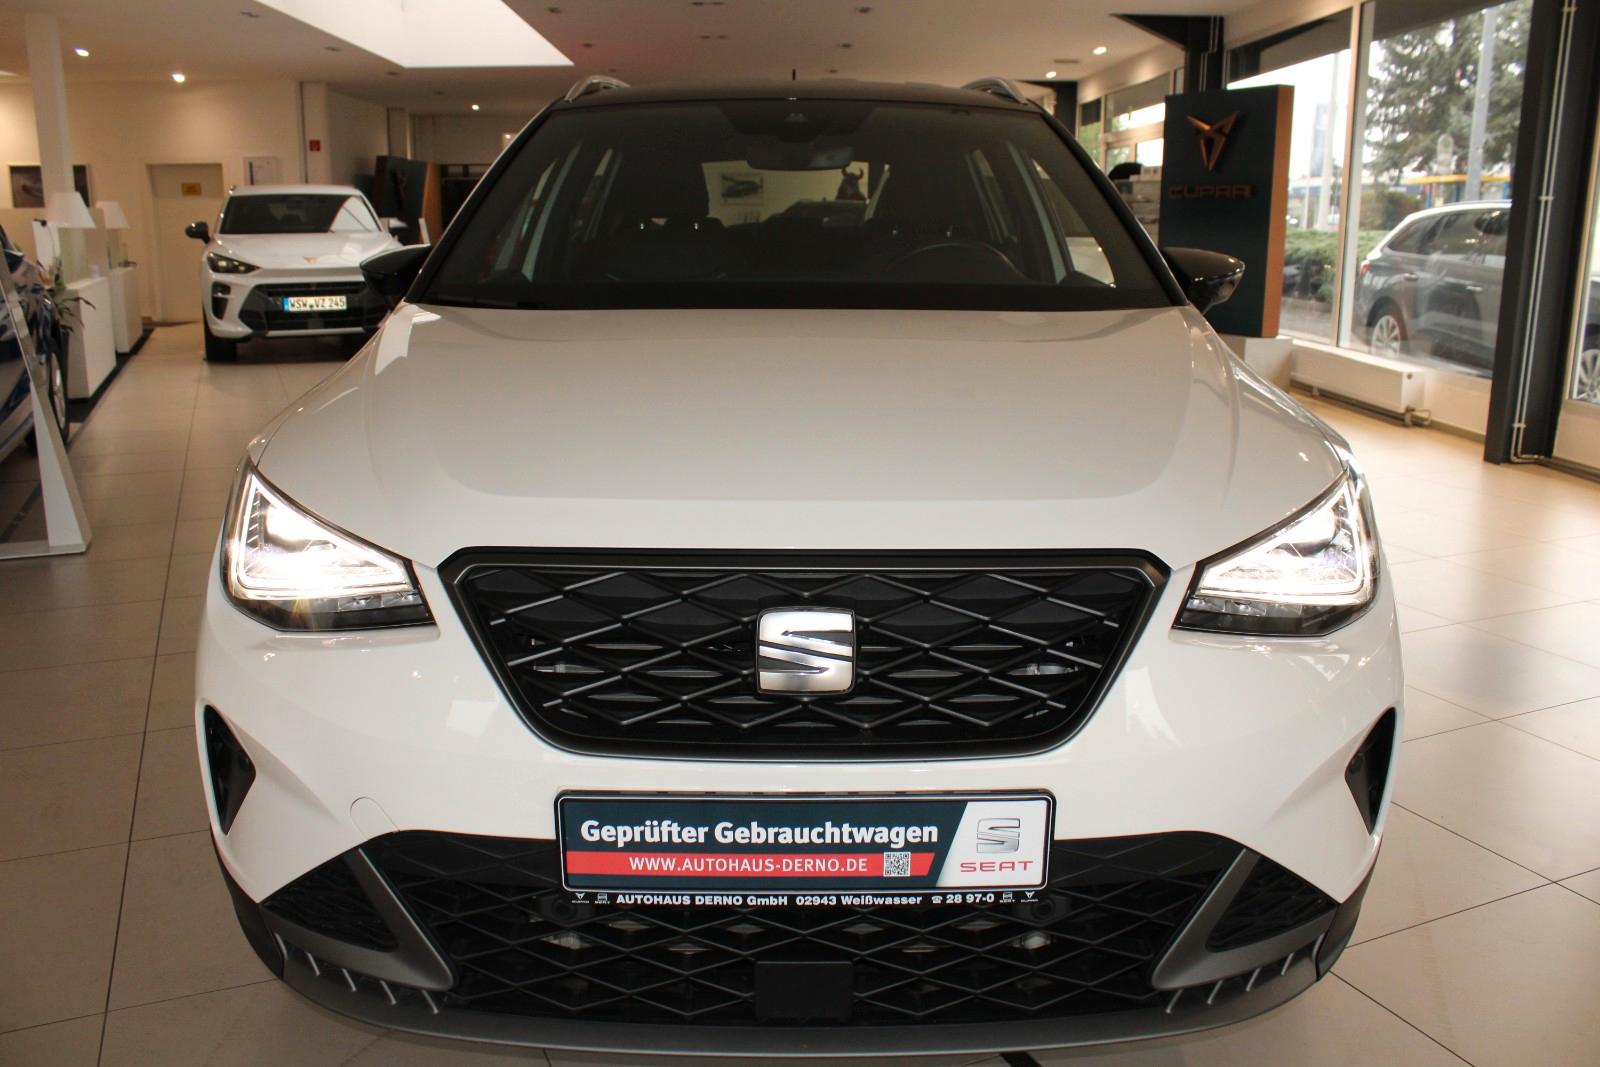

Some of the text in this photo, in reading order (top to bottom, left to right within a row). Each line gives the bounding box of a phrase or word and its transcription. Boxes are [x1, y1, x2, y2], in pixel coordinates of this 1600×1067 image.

[328, 297, 345, 307] 245
[580, 819, 938, 848] Geprüfter Gebrauchtwagen
[629, 856, 868, 873] WWW.AUTOHAUS-DERNO.DE
[960, 860, 1033, 873] SEAT
[616, 894, 691, 905] AUTOHAUS
[695, 895, 743, 906] DERNO
[747, 895, 788, 906] GmbH
[796, 896, 837, 906] 02943
[841, 895, 922, 905] Weißwasser
[946, 894, 962, 904] 28
[966, 893, 995, 903] 97-0
